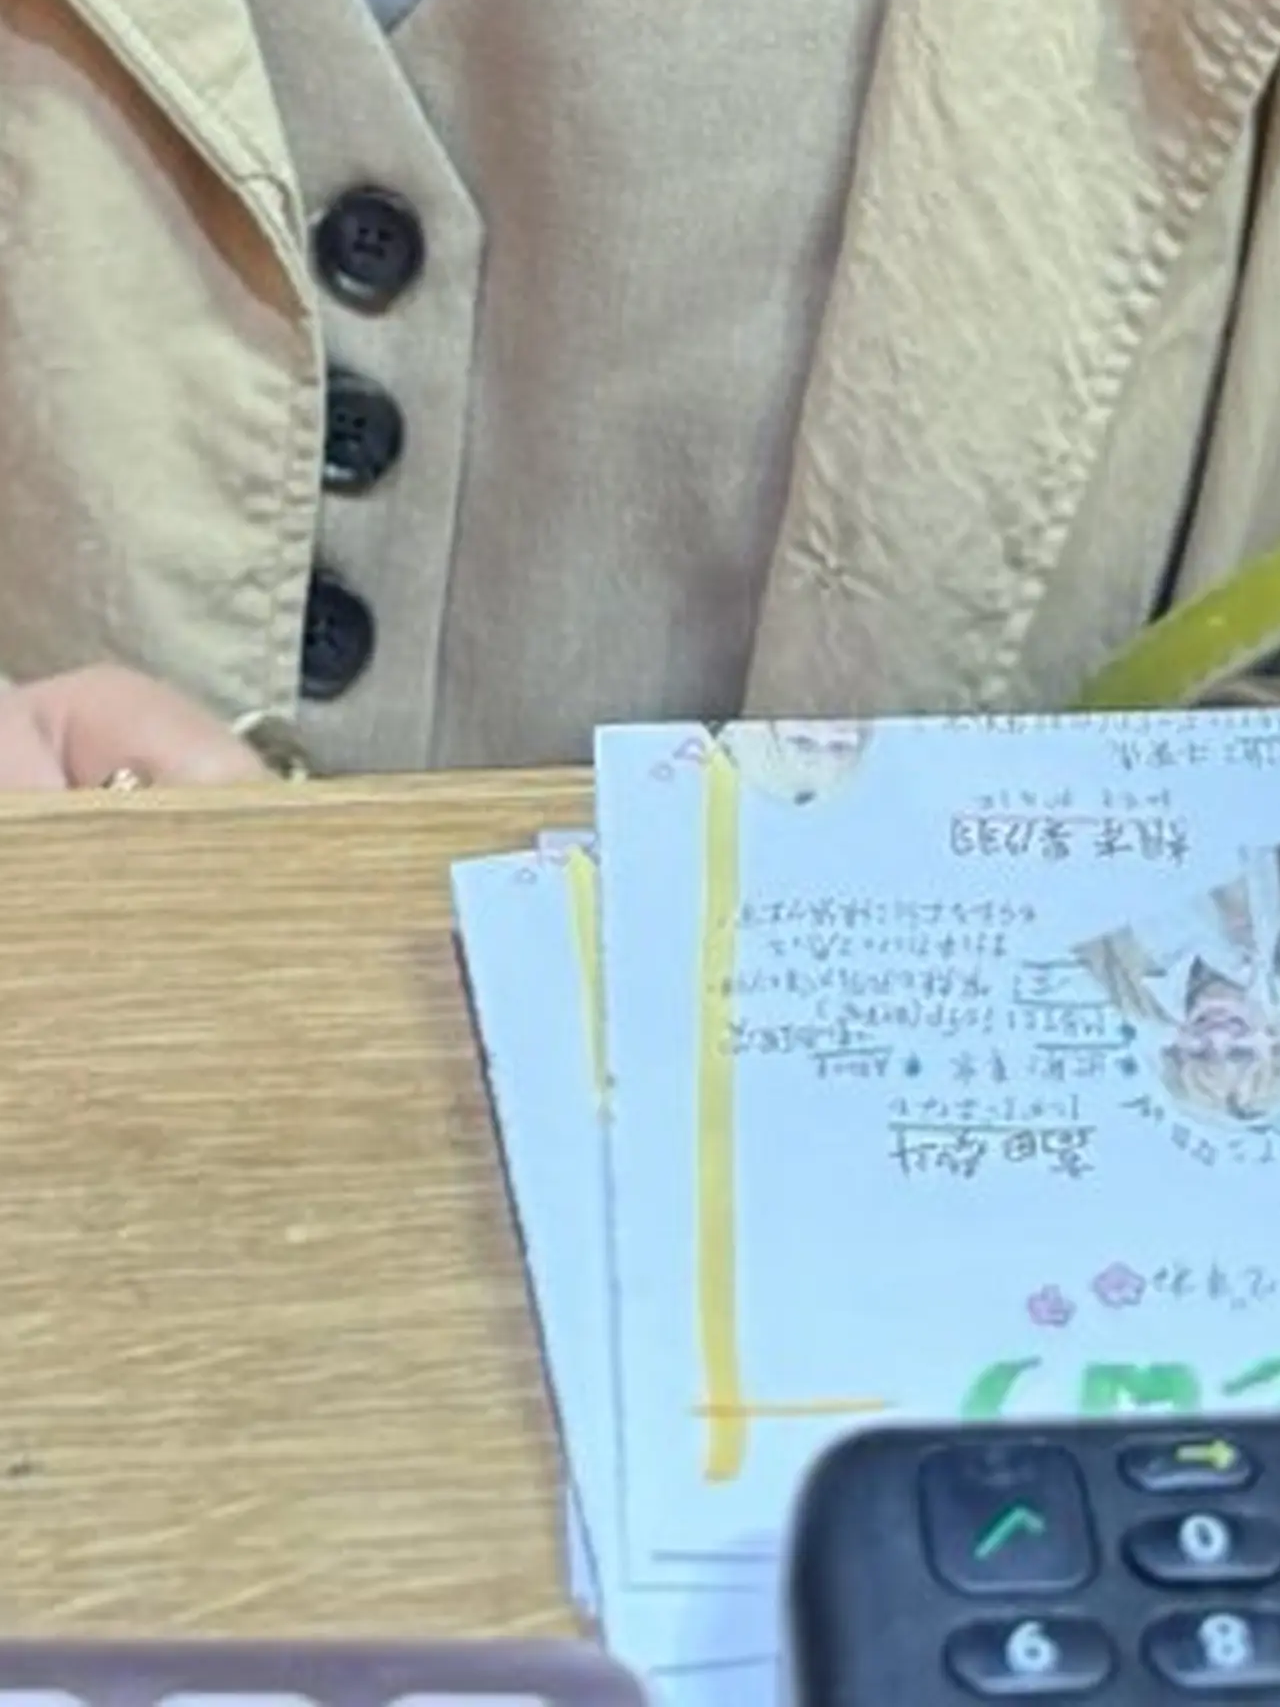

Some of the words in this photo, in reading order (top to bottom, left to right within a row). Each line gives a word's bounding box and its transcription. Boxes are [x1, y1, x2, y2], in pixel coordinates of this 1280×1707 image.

[1178, 1513, 1232, 1565] 0
[1005, 1619, 1060, 1676] 9
[1197, 1612, 1254, 1668] 8
